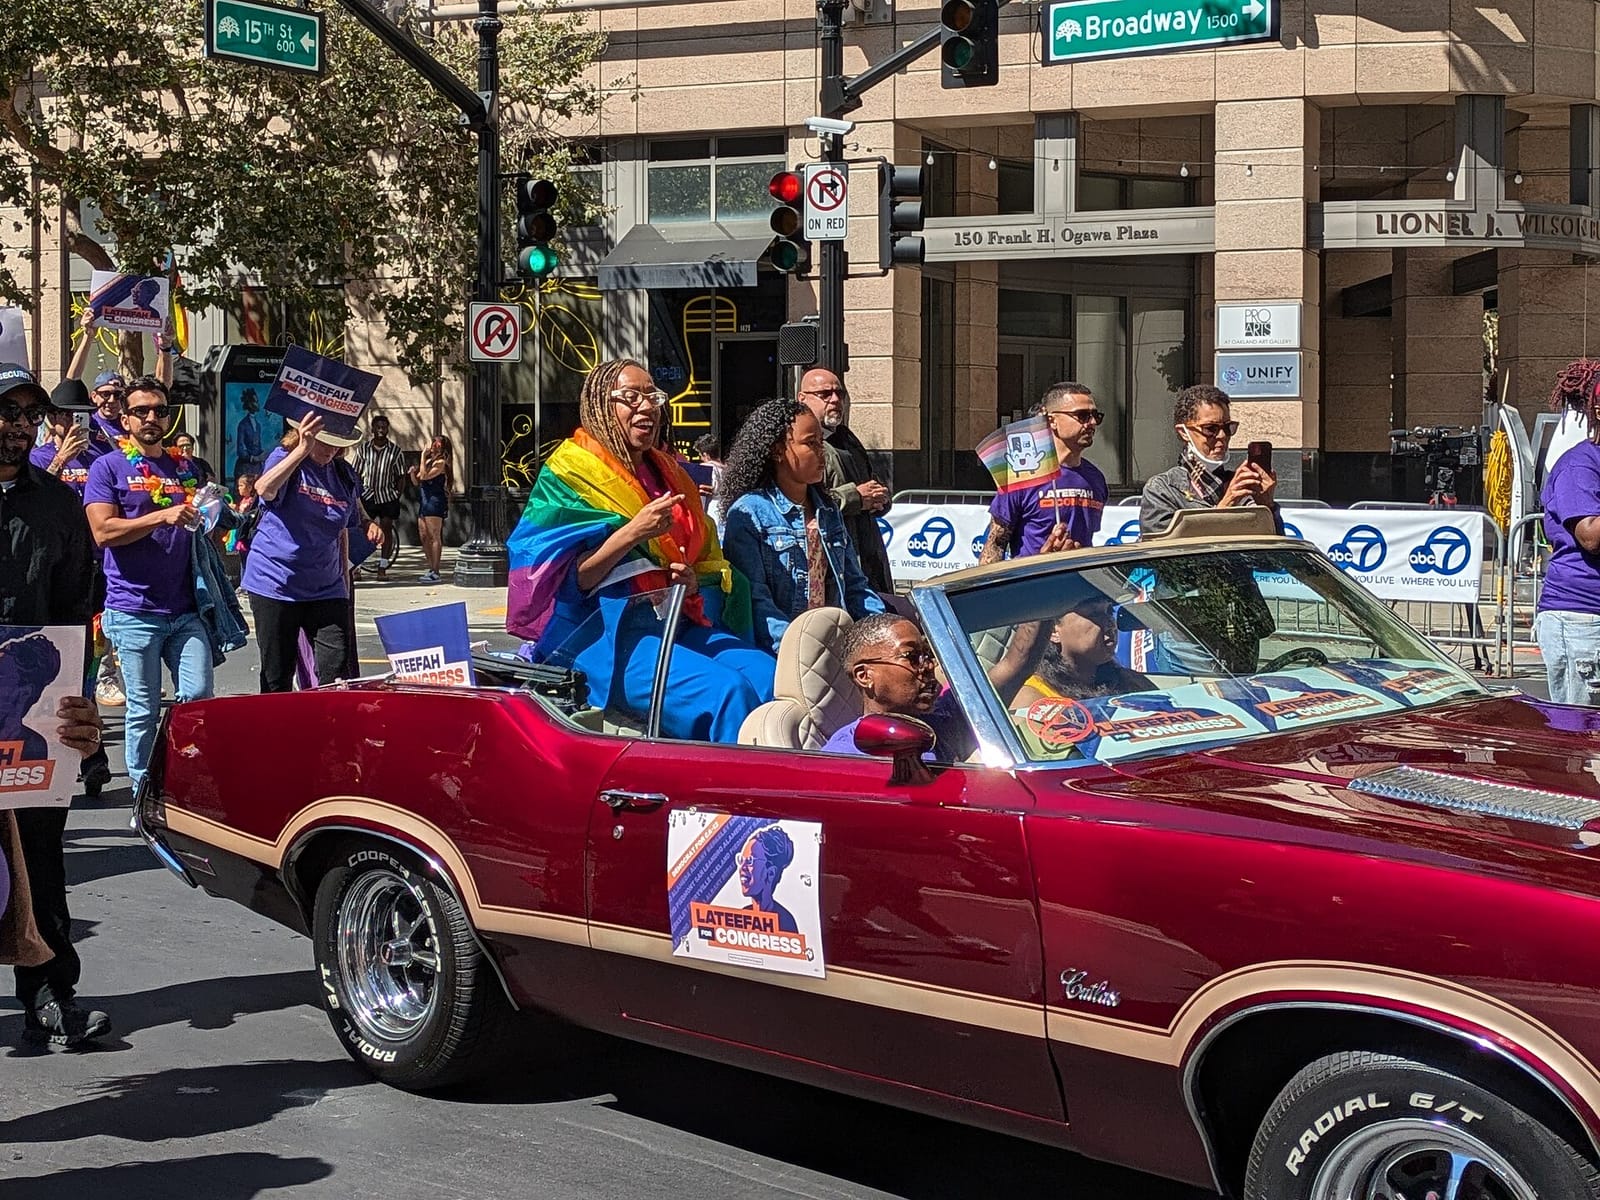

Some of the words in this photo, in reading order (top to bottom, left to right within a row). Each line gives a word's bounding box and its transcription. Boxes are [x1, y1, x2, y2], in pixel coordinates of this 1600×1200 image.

[244, 19, 274, 44] 15TH
[279, 23, 293, 40] St
[1086, 8, 1203, 40] Broadway
[1207, 14, 1238, 29] 1500
[276, 40, 296, 54] 600
[808, 218, 821, 230] ON
[827, 218, 844, 229] RED
[1376, 213, 1474, 235] LIONEL
[1485, 213, 1503, 238] J.
[1515, 214, 1588, 237] WILSON
[954, 232, 982, 246] 150
[987, 229, 1032, 245] Frank
[1037, 229, 1055, 243] H.
[1061, 228, 1112, 245] Ogawa
[1116, 226, 1159, 240] Plaza
[114, 315, 161, 327] CONGRESS
[1245, 308, 1271, 323] PRO
[1245, 322, 1271, 336] ARTS
[1247, 366, 1293, 378] UNIFY
[285, 371, 349, 401] LATEEFAH
[298, 385, 360, 413] CONGRESS
[907, 538, 928, 550] abc
[972, 541, 985, 553] ab
[901, 560, 926, 568] WHERE
[927, 561, 943, 569] YOU
[944, 561, 960, 569] LIVE
[1327, 551, 1353, 562] abc
[1408, 554, 1436, 565] abc
[1355, 575, 1373, 584] YOU
[1375, 576, 1394, 585] LIVE
[1401, 577, 1434, 586] WHERE
[1437, 579, 1456, 587] YOU
[1459, 579, 1479, 588] LIVE
[395, 653, 440, 674] ATEEFAH
[1098, 713, 1197, 732] LATEEFAH
[1132, 717, 1236, 738] CONGRESS
[0, 766, 45, 786] ESS
[348, 850, 410, 879] COOPER
[670, 846, 698, 878] DEMOCRAT
[694, 836, 707, 849] FOR
[696, 908, 774, 933] LATEEFAH
[716, 928, 802, 955] CONGRESS
[320, 963, 340, 1010] G/T
[343, 1018, 397, 1063] RADIAL
[1285, 1092, 1390, 1177] RADIAL
[1408, 1091, 1485, 1125] G/T
